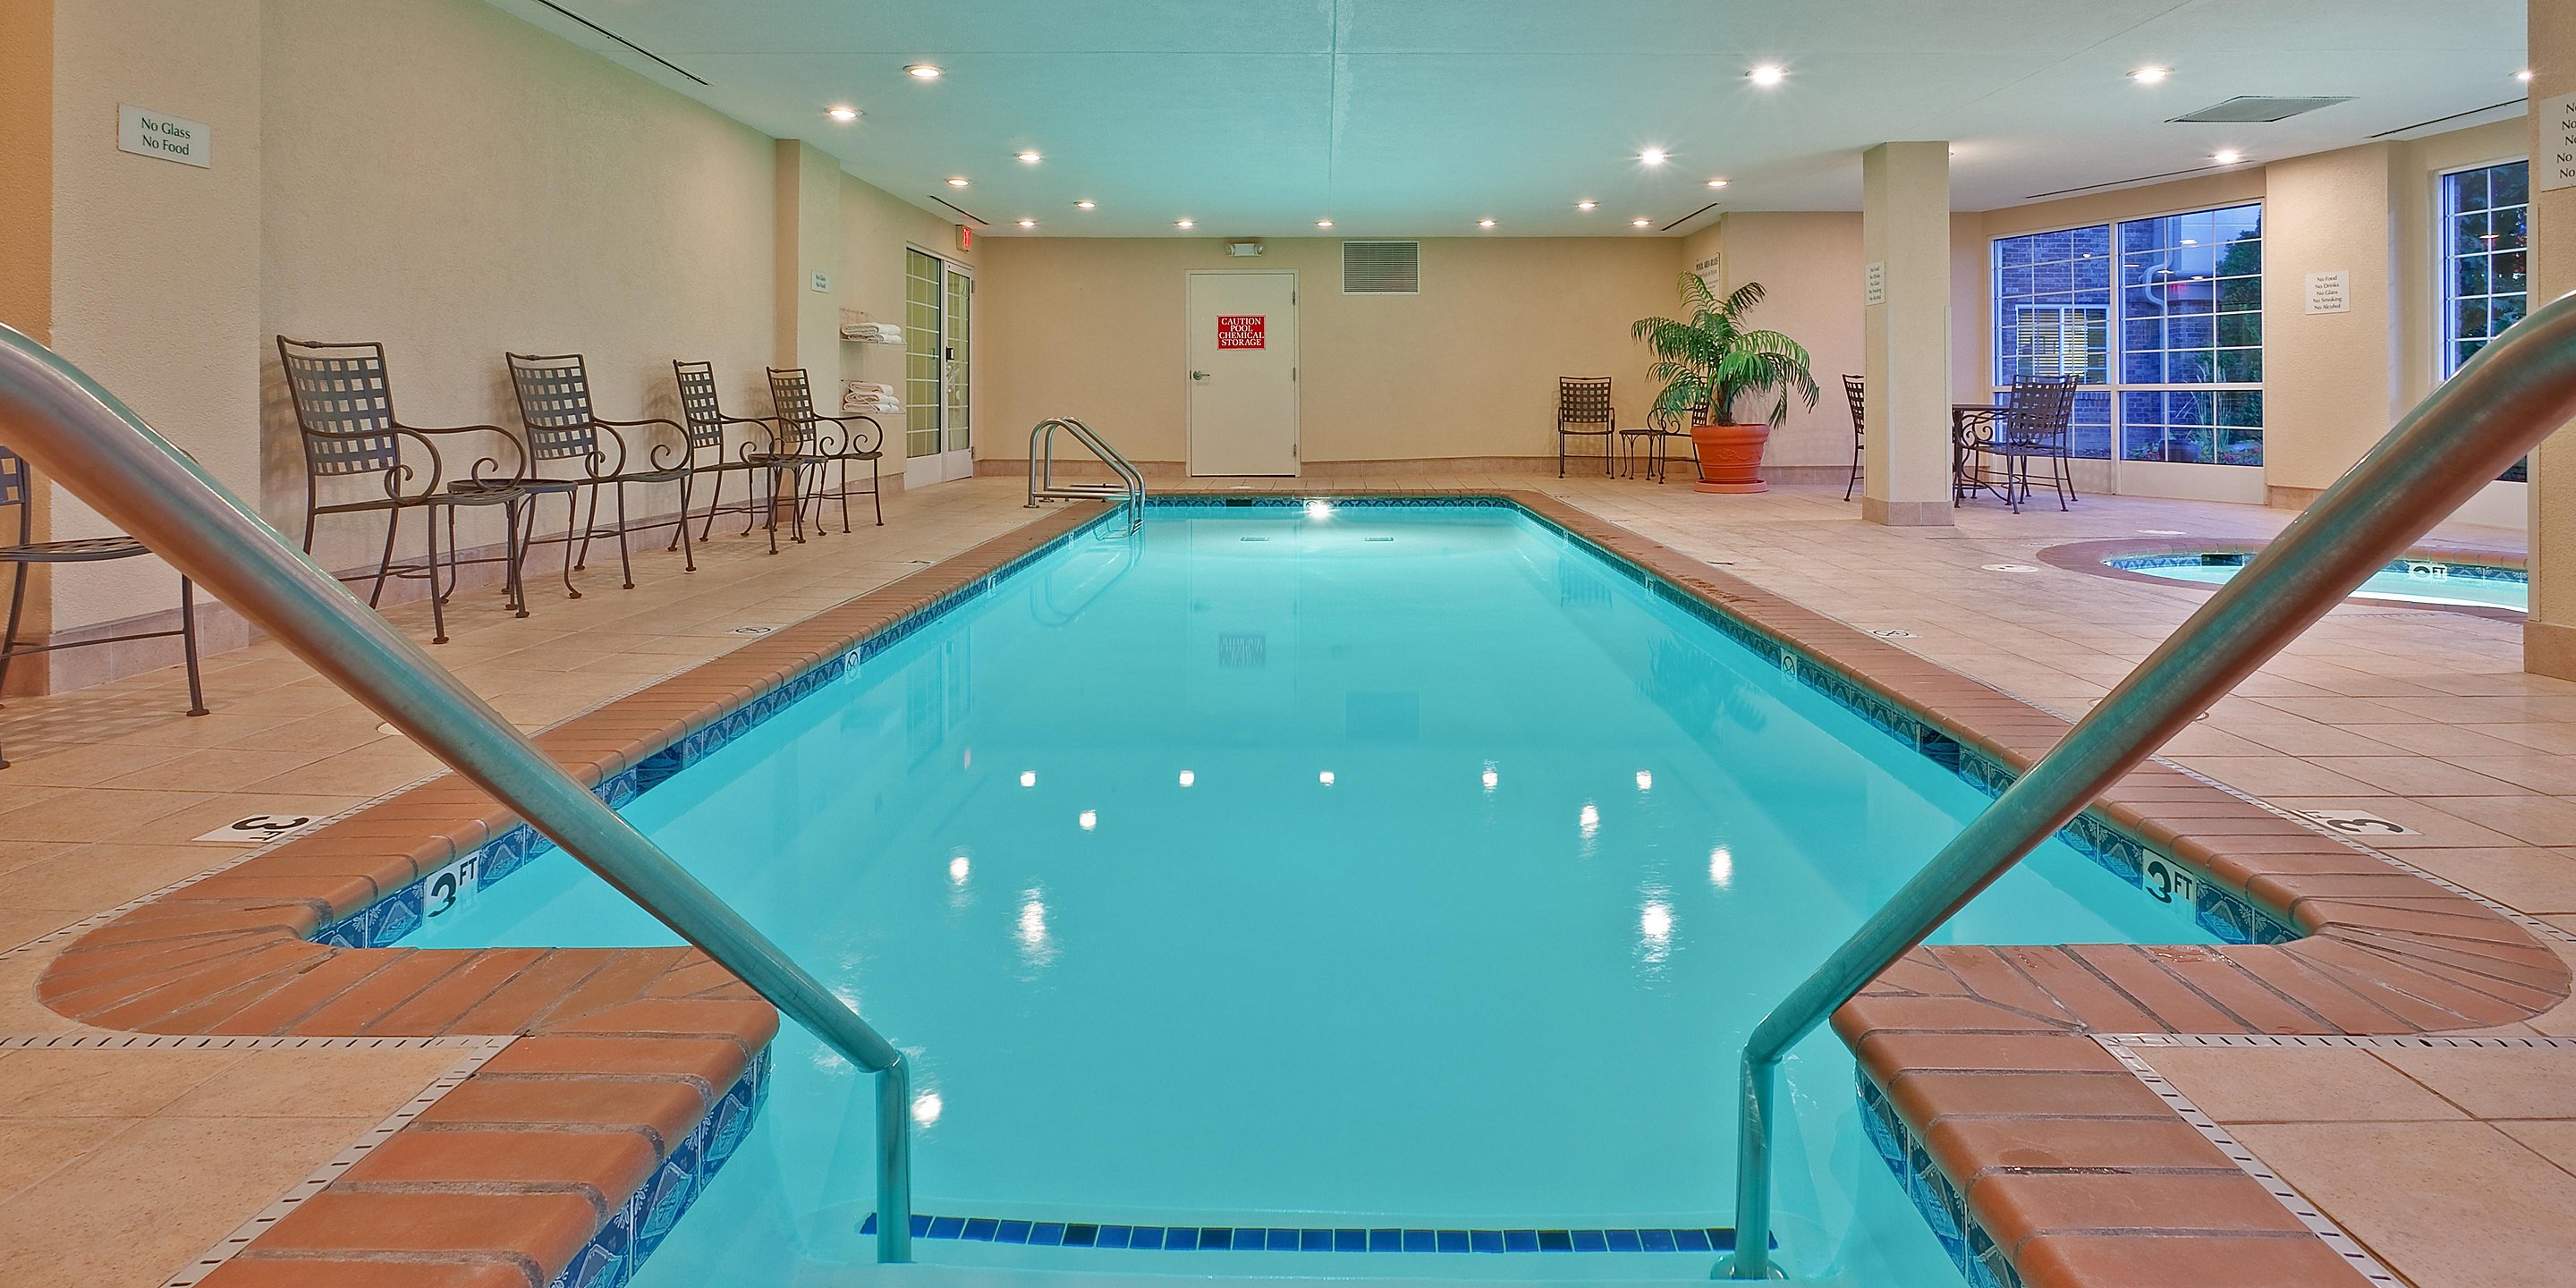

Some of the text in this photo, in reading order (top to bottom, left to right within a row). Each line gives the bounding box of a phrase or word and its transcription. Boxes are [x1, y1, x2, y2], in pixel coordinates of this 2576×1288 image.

[2566, 103, 2576, 114] N
[141, 118, 191, 140] No Glass
[142, 135, 190, 156] No Food
[2556, 152, 2572, 164] No
[2560, 167, 2575, 179] No
[1221, 318, 1261, 326] CAUTION
[1218, 331, 1265, 339] CHEMICAL
[232, 816, 309, 831] 3
[2326, 818, 2404, 833] 3
[428, 857, 478, 918] 3 FT
[2145, 860, 2192, 903] 3 FT
